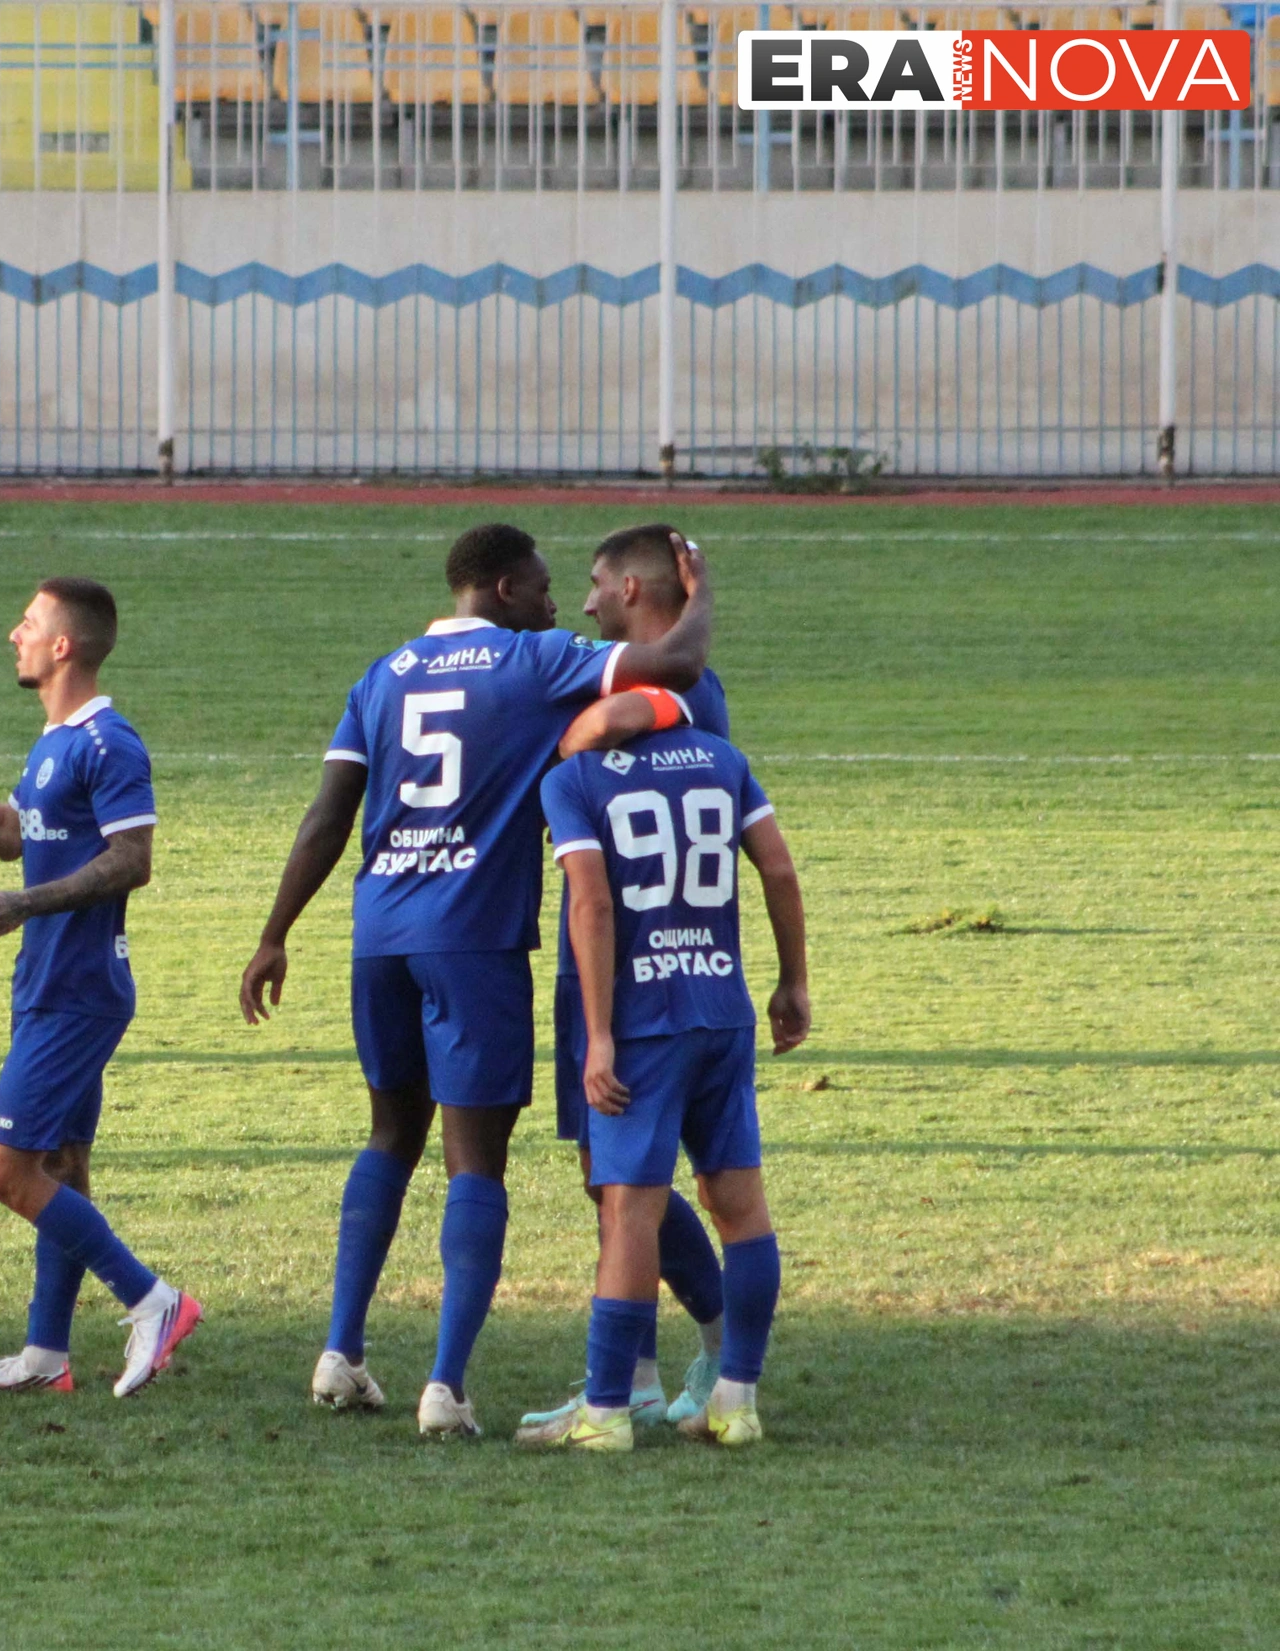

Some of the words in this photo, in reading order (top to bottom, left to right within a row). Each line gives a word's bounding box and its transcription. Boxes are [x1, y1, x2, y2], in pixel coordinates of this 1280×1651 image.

[428, 647, 492, 668] ЛИНА
[400, 690, 465, 808] 5
[371, 847, 477, 876] БУРГАС
[606, 788, 734, 912] 98
[632, 951, 734, 983] БУРГАС
